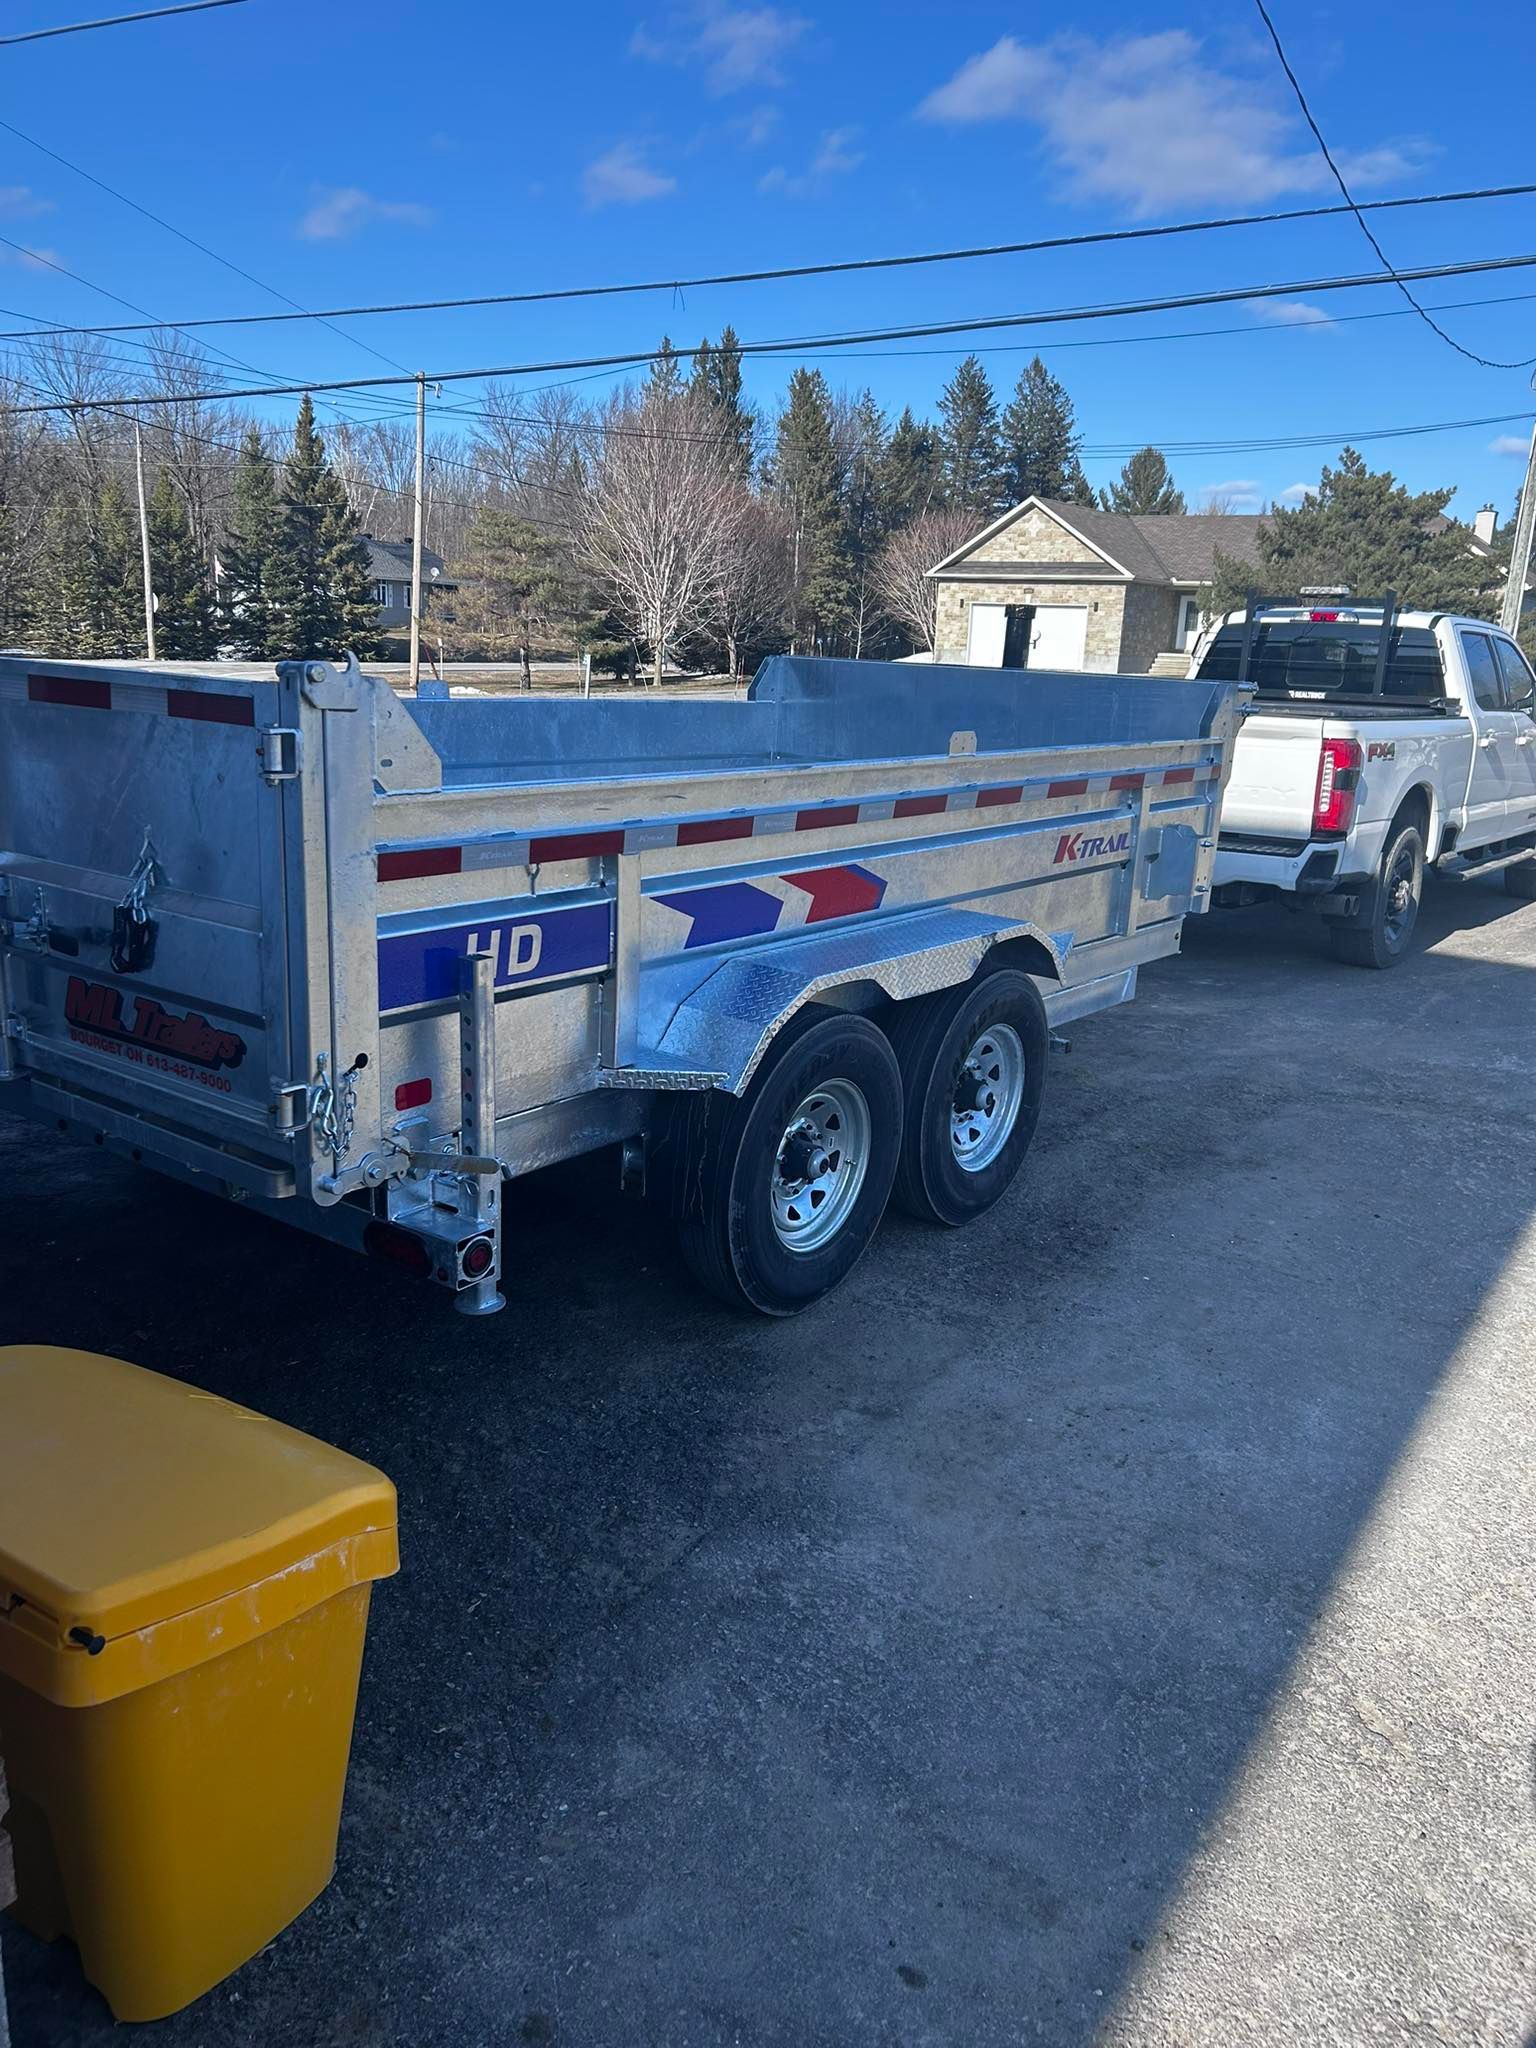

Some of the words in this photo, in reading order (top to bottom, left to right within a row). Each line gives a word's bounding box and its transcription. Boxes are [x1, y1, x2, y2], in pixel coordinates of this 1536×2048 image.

[1368, 742, 1395, 762] FX4
[1053, 832, 1129, 864] K-TRAIL
[467, 924, 542, 978] HD
[65, 976, 122, 1033] ML
[70, 1029, 123, 1057] BOURGET
[127, 1047, 144, 1064] ON
